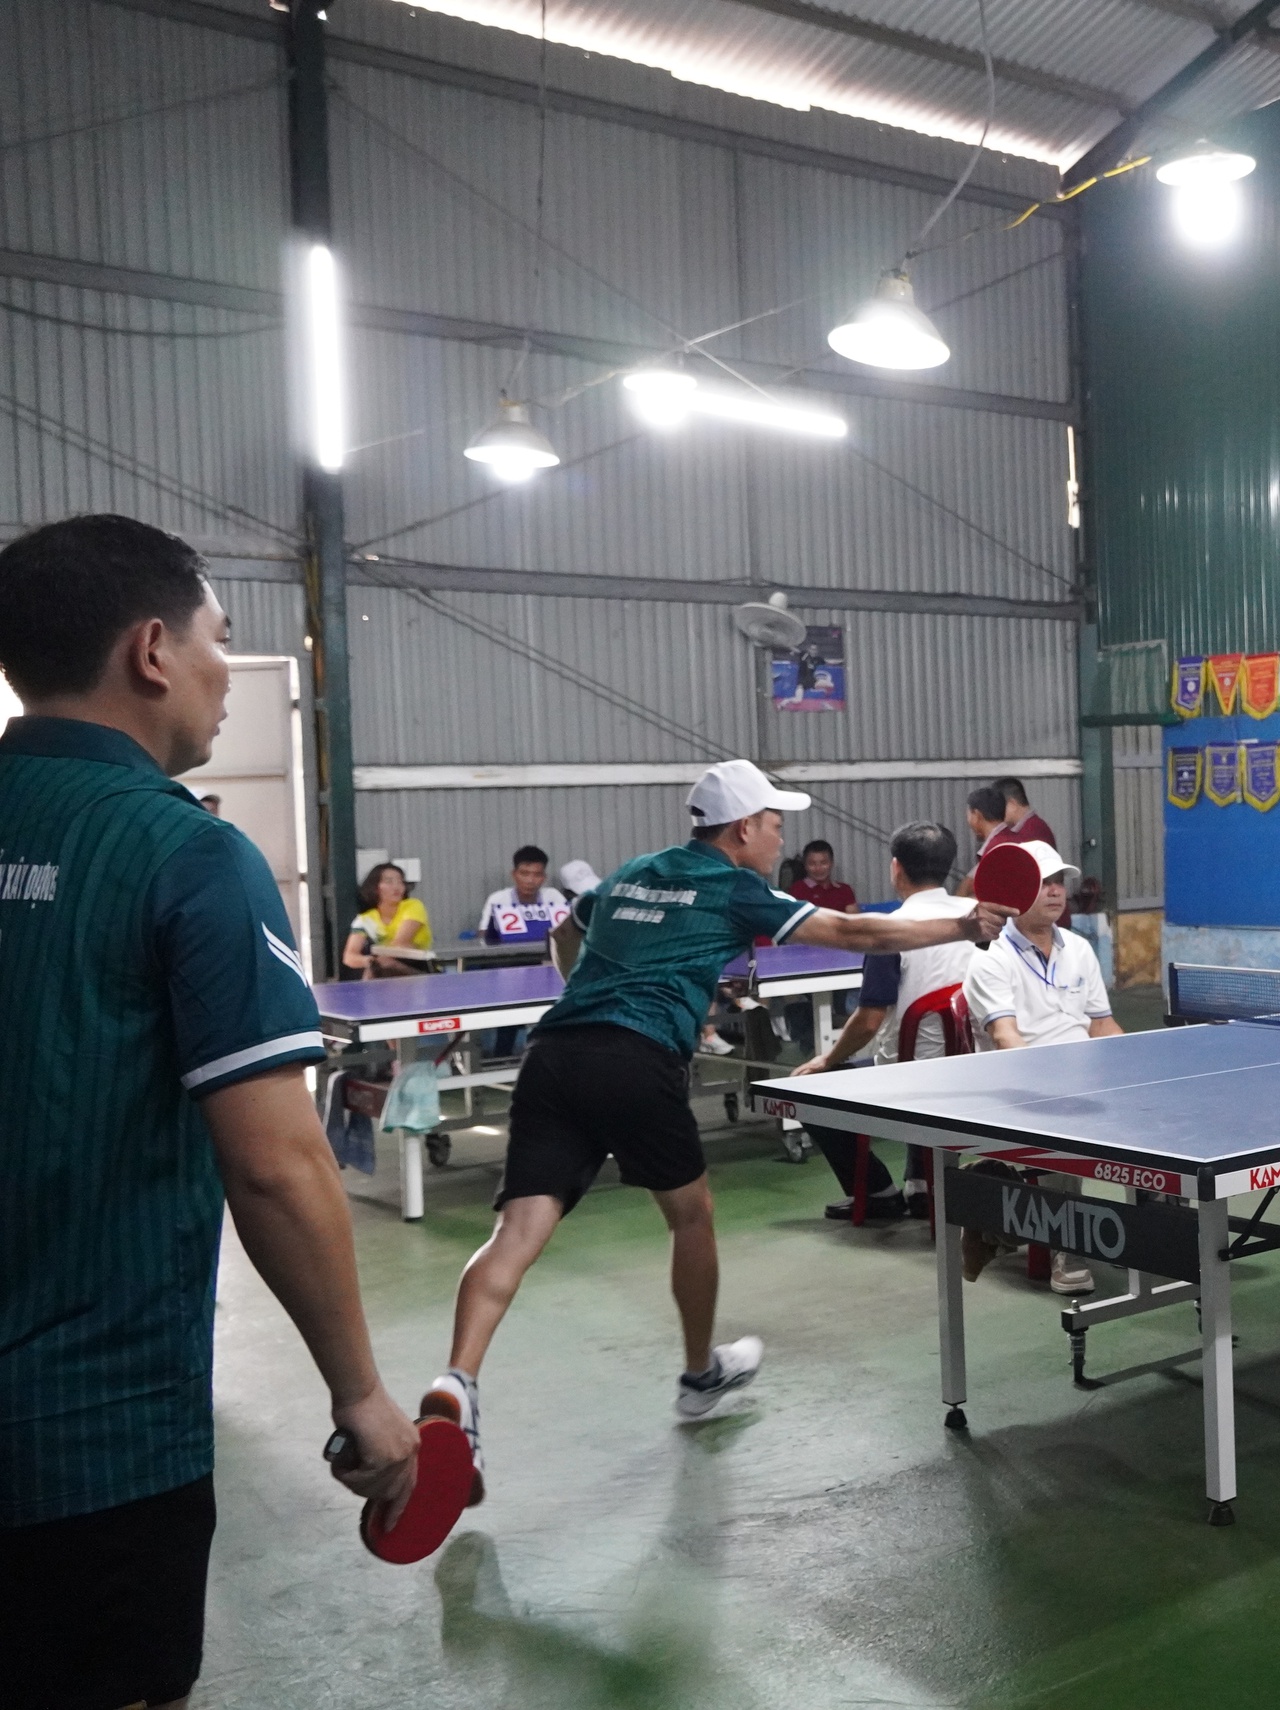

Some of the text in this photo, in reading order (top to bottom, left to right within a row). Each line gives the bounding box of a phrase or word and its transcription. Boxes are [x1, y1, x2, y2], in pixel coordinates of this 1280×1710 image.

[502, 913, 523, 932] 2
[763, 1098, 797, 1119] KAMITO
[1094, 1162, 1166, 1191] 6825 ECO
[1002, 1185, 1126, 1259] KAMITO
